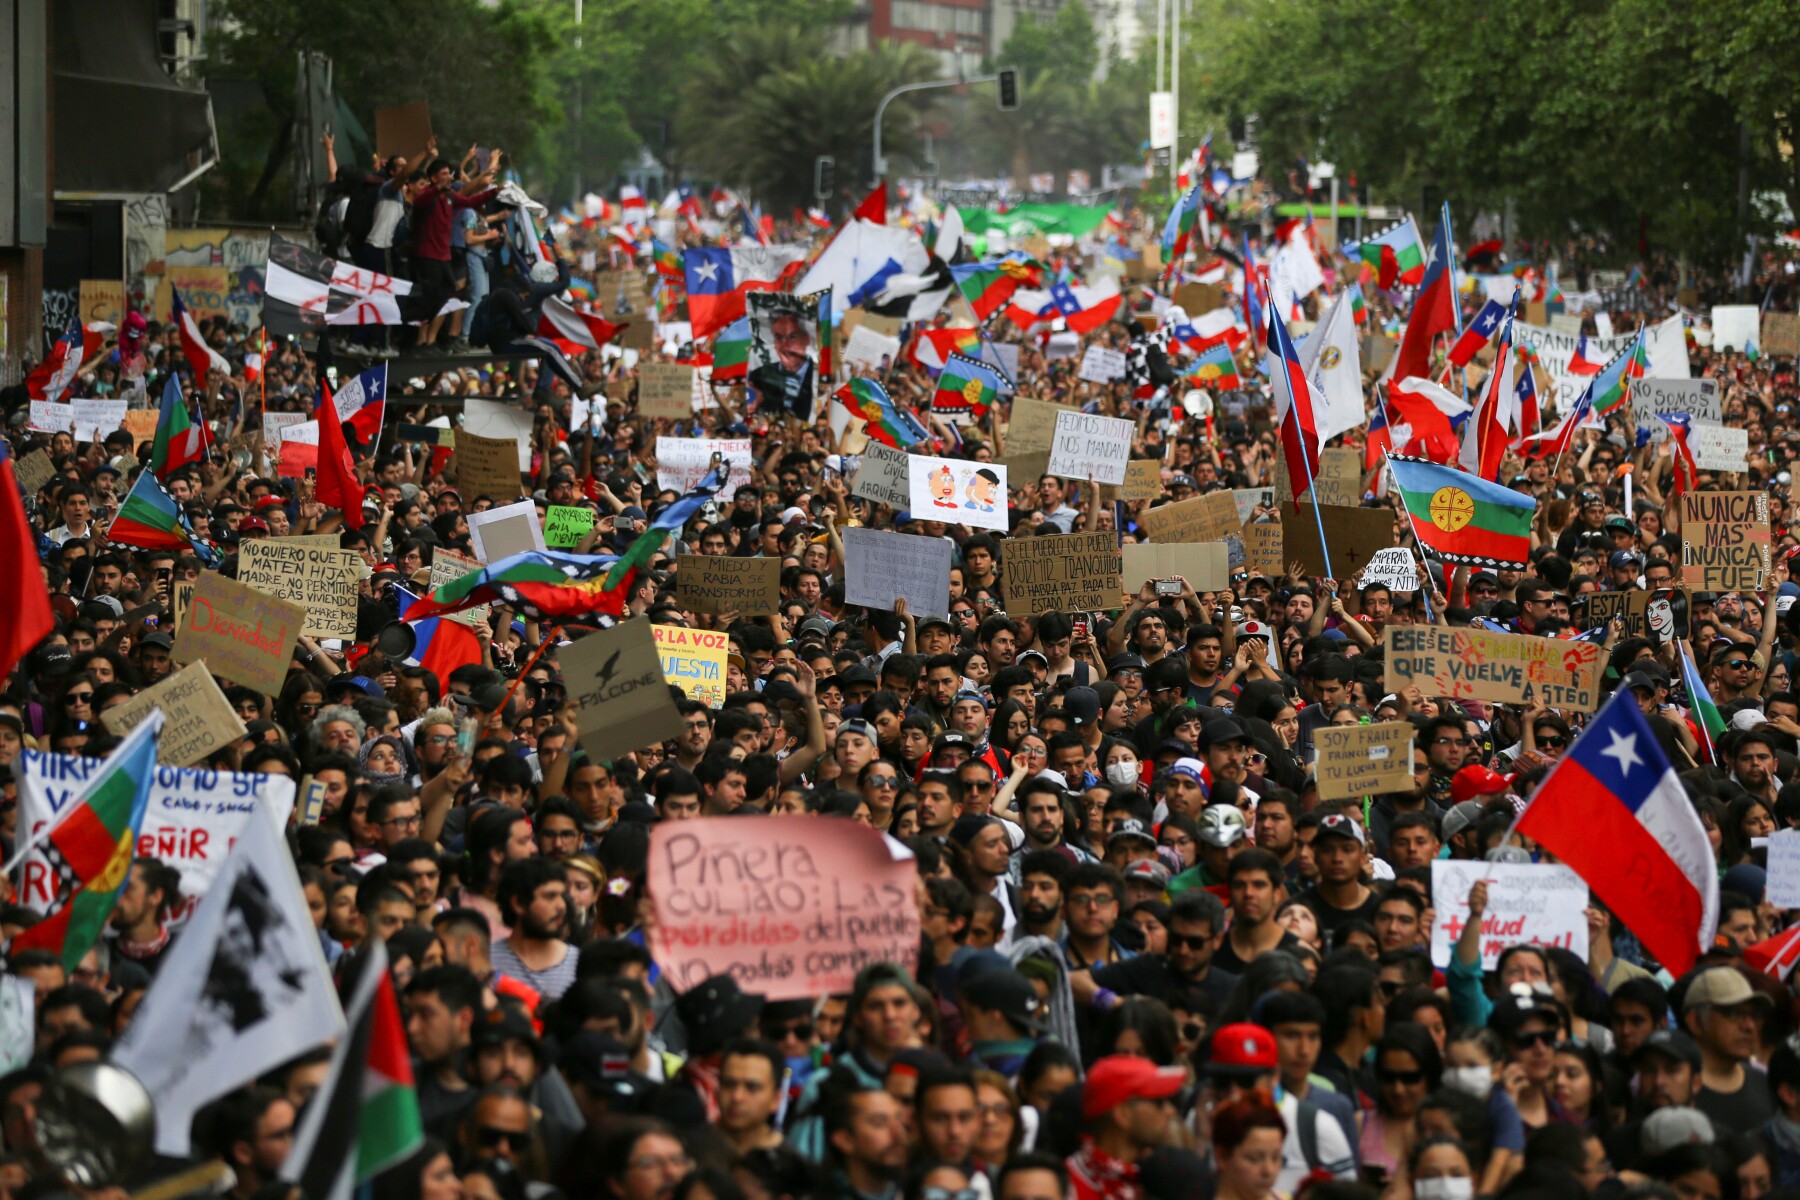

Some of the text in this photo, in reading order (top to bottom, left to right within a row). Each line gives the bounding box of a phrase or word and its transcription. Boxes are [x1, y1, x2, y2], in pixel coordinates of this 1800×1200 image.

[1632, 381, 1710, 407] NO SOMOS
[1060, 435, 1125, 460] NOS MANDAN
[261, 545, 306, 562] QUIERO
[308, 550, 336, 564] QUE
[339, 551, 360, 566] TE
[1005, 532, 1115, 560] SI EL PUEBLO NO PUEDE
[251, 557, 305, 576] MATEN
[433, 562, 452, 574] QUE
[681, 557, 768, 572] EL MIEDO Y
[1007, 554, 1119, 586] DORMIR TRANQUILO
[1374, 564, 1411, 576] CABEZA
[287, 576, 303, 590] NO
[703, 572, 743, 585] RABIA
[749, 574, 767, 584] SE
[1009, 584, 1025, 601] NO
[1060, 580, 1080, 597] PAZ
[1082, 577, 1104, 593] PARA
[1106, 576, 1121, 590] EL
[307, 593, 358, 607] VIVIENDO
[679, 584, 768, 598] TRANSFORMÓ
[1031, 596, 1063, 614] ESTADO
[668, 630, 688, 645] LA
[692, 632, 726, 650] VOZ
[1438, 633, 1462, 655] EL
[1393, 657, 1523, 689] QUE VUELVE
[1521, 680, 1536, 701] A
[1323, 728, 1400, 750] SOY FRAILE
[1325, 765, 1342, 779] TU
[1346, 762, 1377, 777] LUCHA
[1347, 778, 1380, 793] LUCHA
[665, 833, 821, 886] Piñera
[804, 910, 844, 944] del
